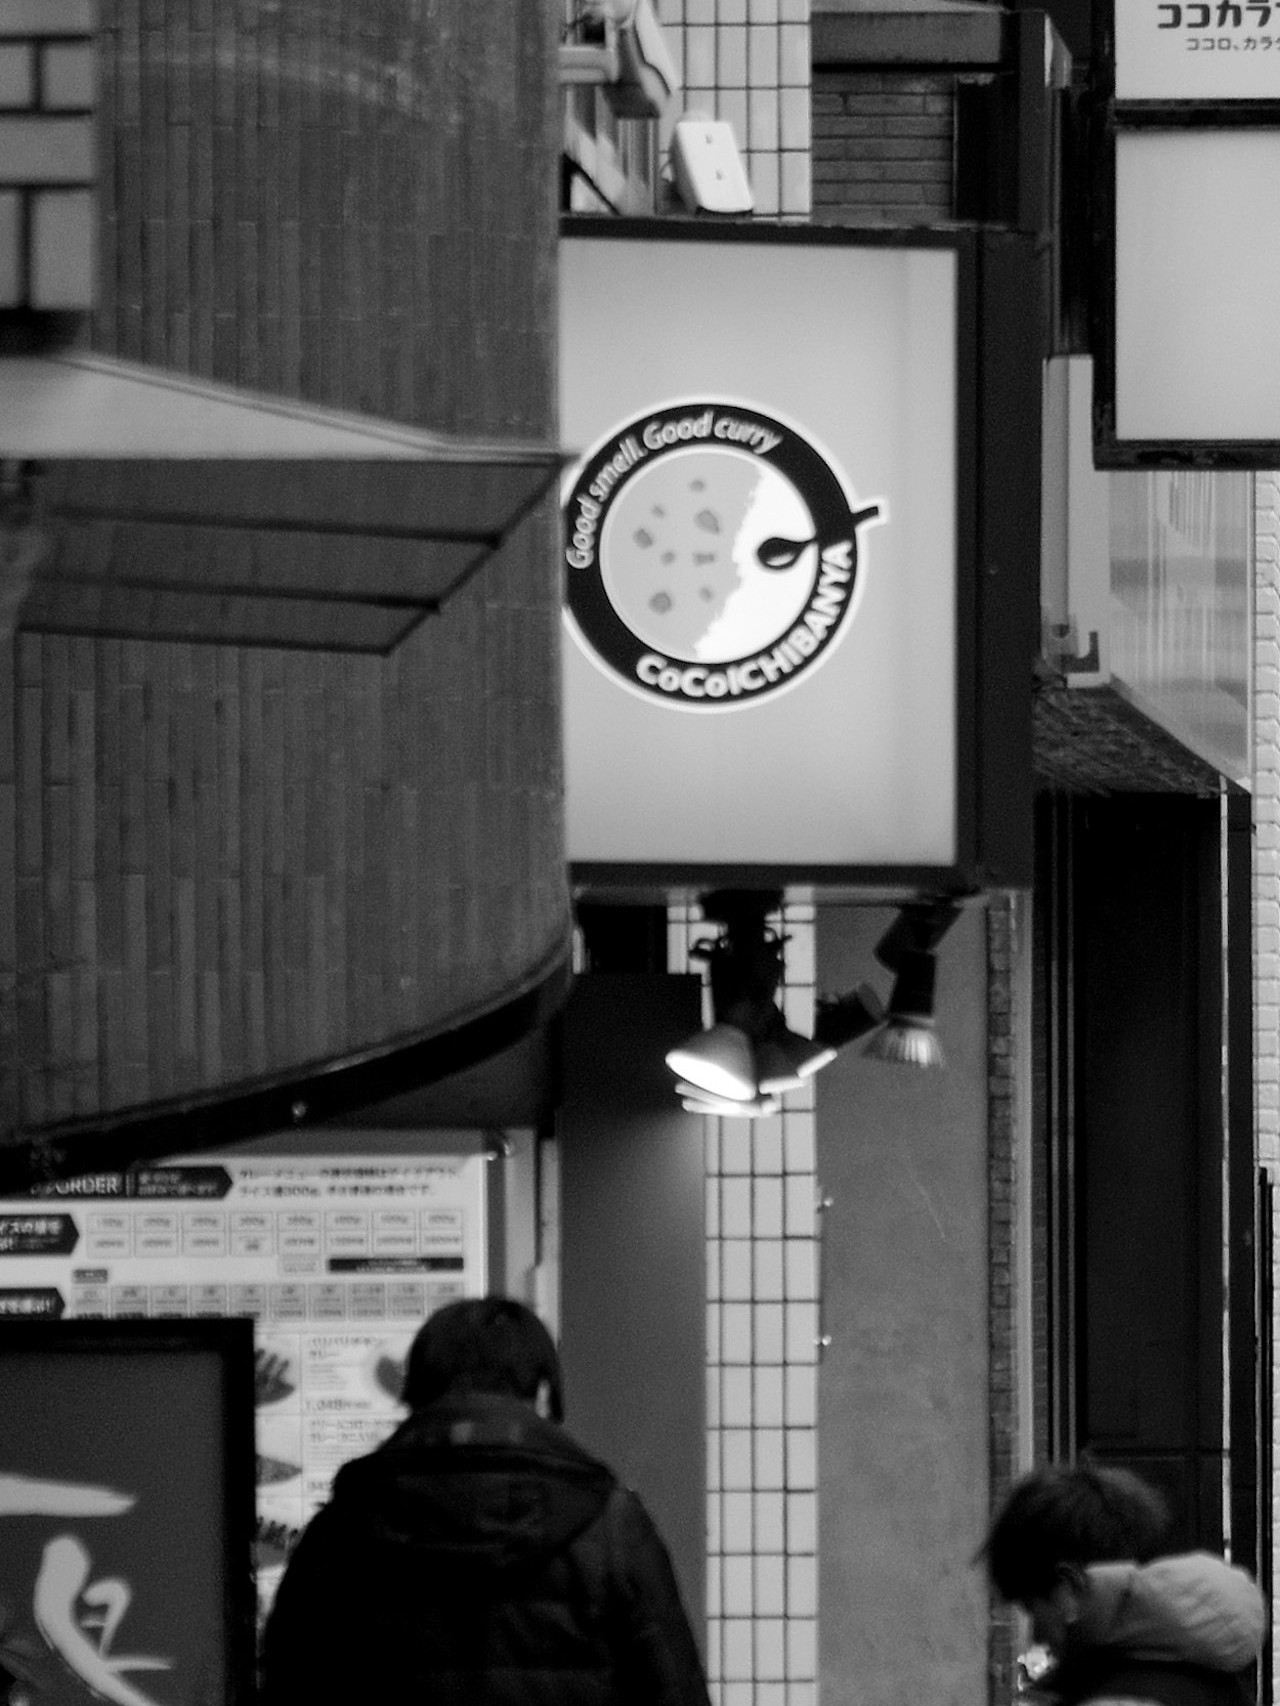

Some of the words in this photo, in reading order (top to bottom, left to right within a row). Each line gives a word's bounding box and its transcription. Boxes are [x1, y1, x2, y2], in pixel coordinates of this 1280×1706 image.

[565, 499, 600, 570] Good
[642, 409, 716, 454] Good
[713, 416, 783, 456] curry
